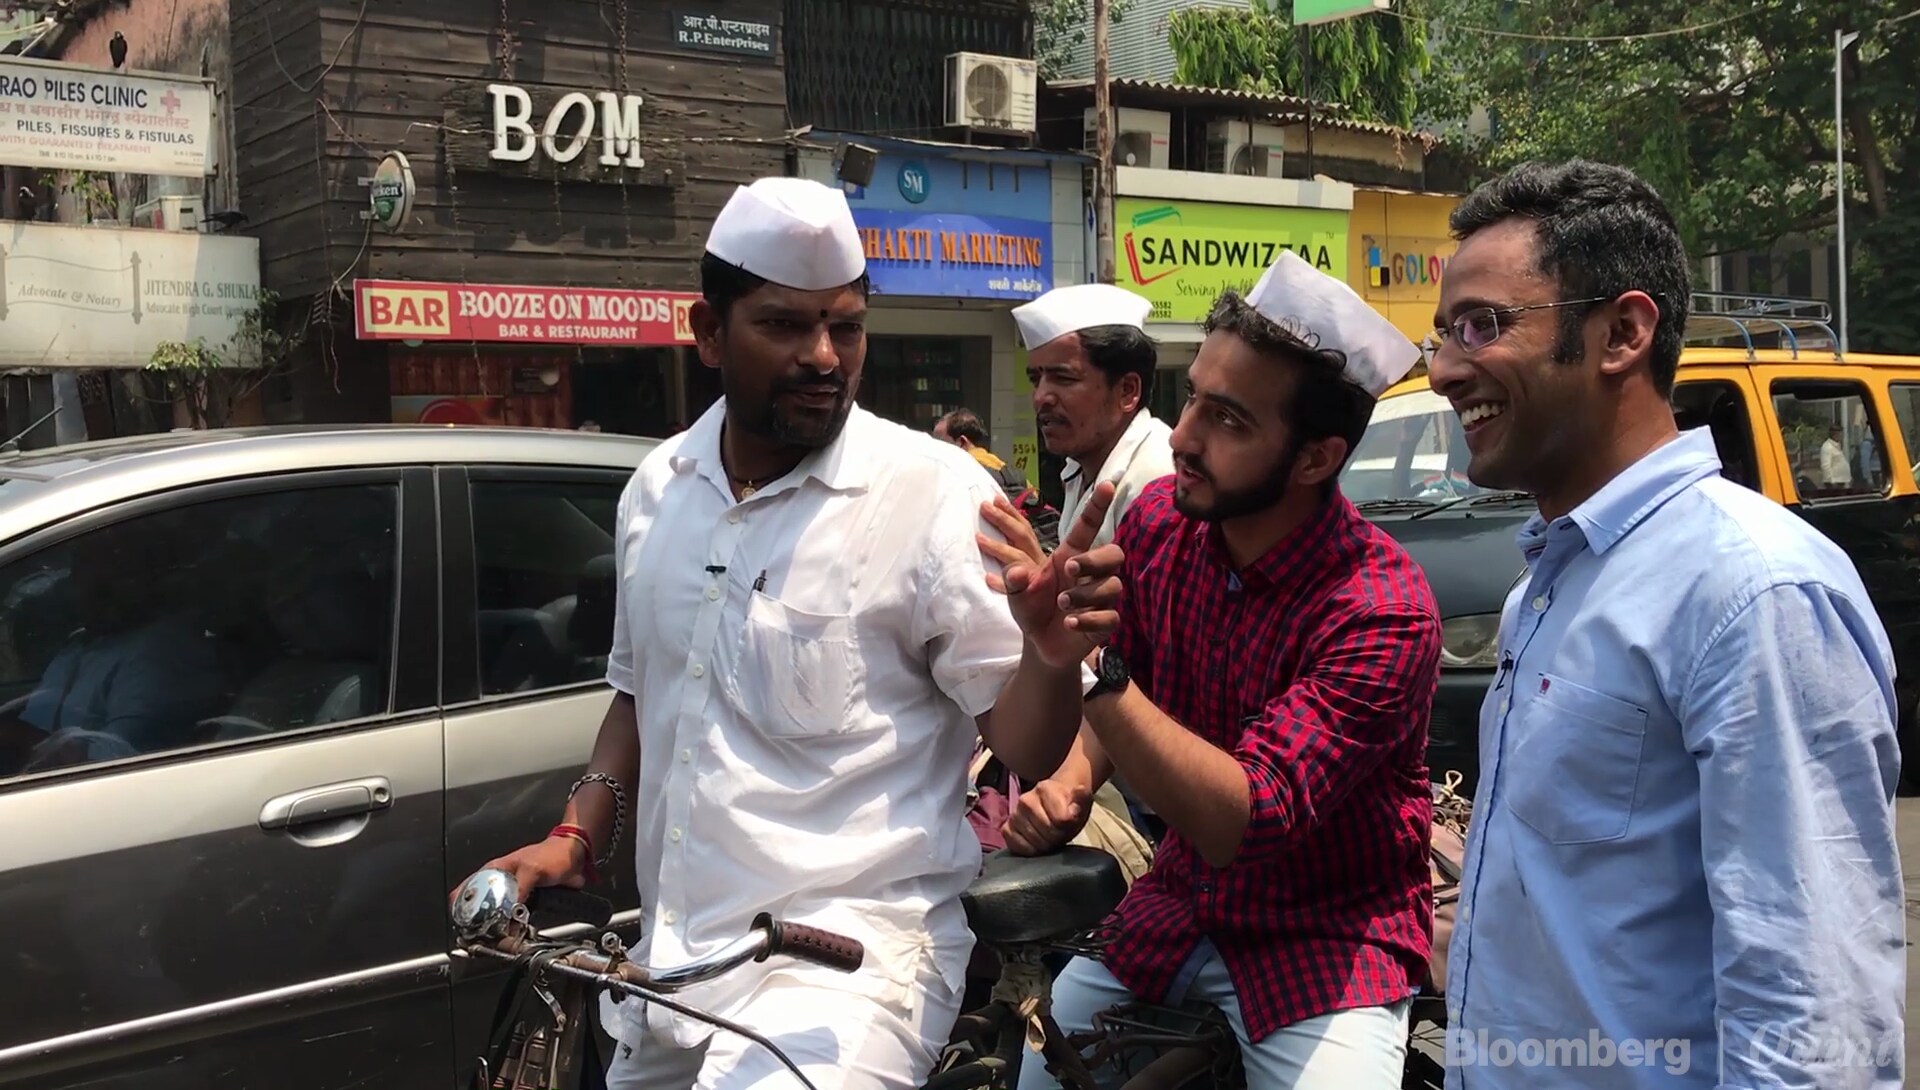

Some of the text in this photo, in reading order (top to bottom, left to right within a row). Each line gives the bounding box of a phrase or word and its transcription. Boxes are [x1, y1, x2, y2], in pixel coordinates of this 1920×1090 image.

[0, 75, 148, 109] RAO PILES CLINIC
[61, 124, 120, 139] FISSURES
[125, 129, 135, 140] &
[139, 130, 194, 144] FISTULAS
[487, 83, 645, 169] BOM
[858, 227, 1043, 268] HAKTI MARKETING
[18, 284, 121, 310] Advocate & Notary
[144, 279, 258, 300] JITENDRA G. SHUKLA
[1176, 278, 1216, 299] Serving
[202, 304, 222, 316] Court
[370, 295, 446, 328] BAR
[458, 290, 671, 323] BOOZE ON MOODS
[499, 324, 638, 340] BAR & RESTAURANT
